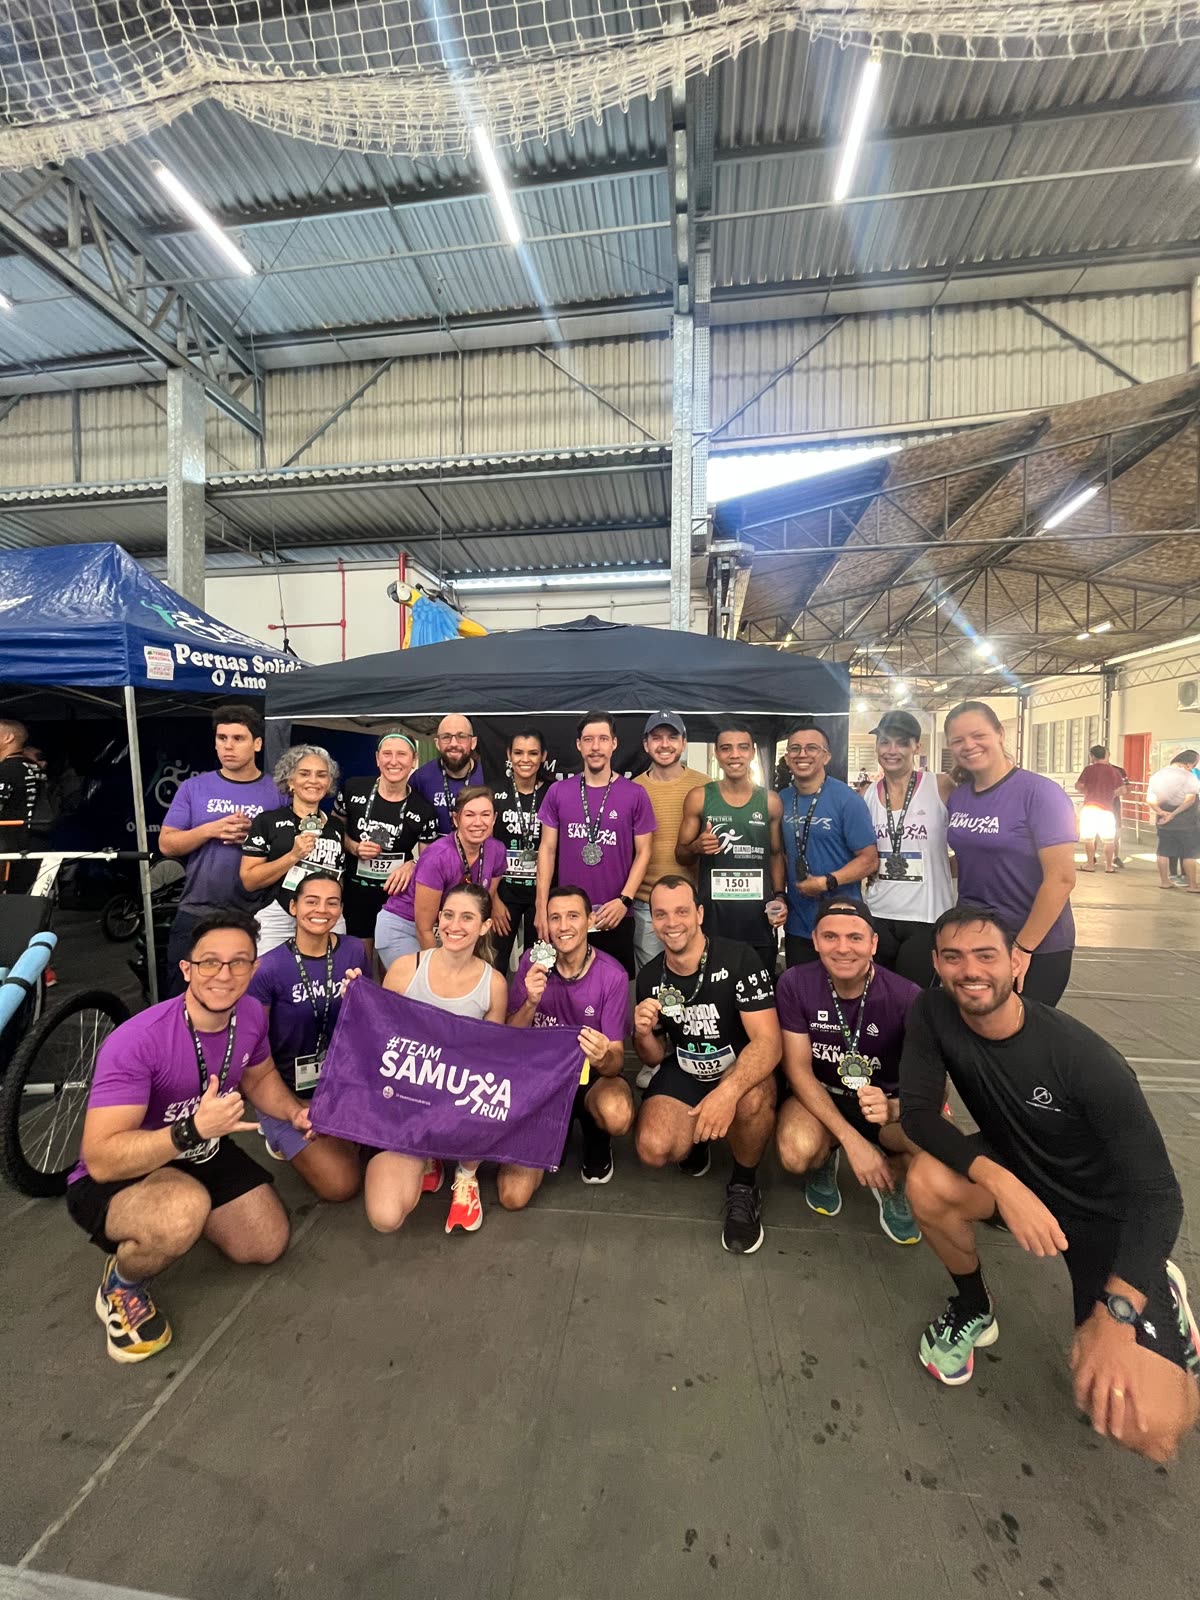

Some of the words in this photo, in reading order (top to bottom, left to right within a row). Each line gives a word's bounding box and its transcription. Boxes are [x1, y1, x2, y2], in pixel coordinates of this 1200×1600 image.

[174, 643, 249, 672] Pernas
[211, 669, 226, 687] O
[230, 672, 267, 690] Amo
[369, 859, 392, 870] 1357
[725, 878, 749, 888] 1501
[710, 967, 729, 983] rvb
[386, 1036, 442, 1061] #TEAM
[812, 1042, 841, 1052] #TEAM
[691, 1059, 722, 1071] 1032
[480, 1103, 509, 1122] RUN
